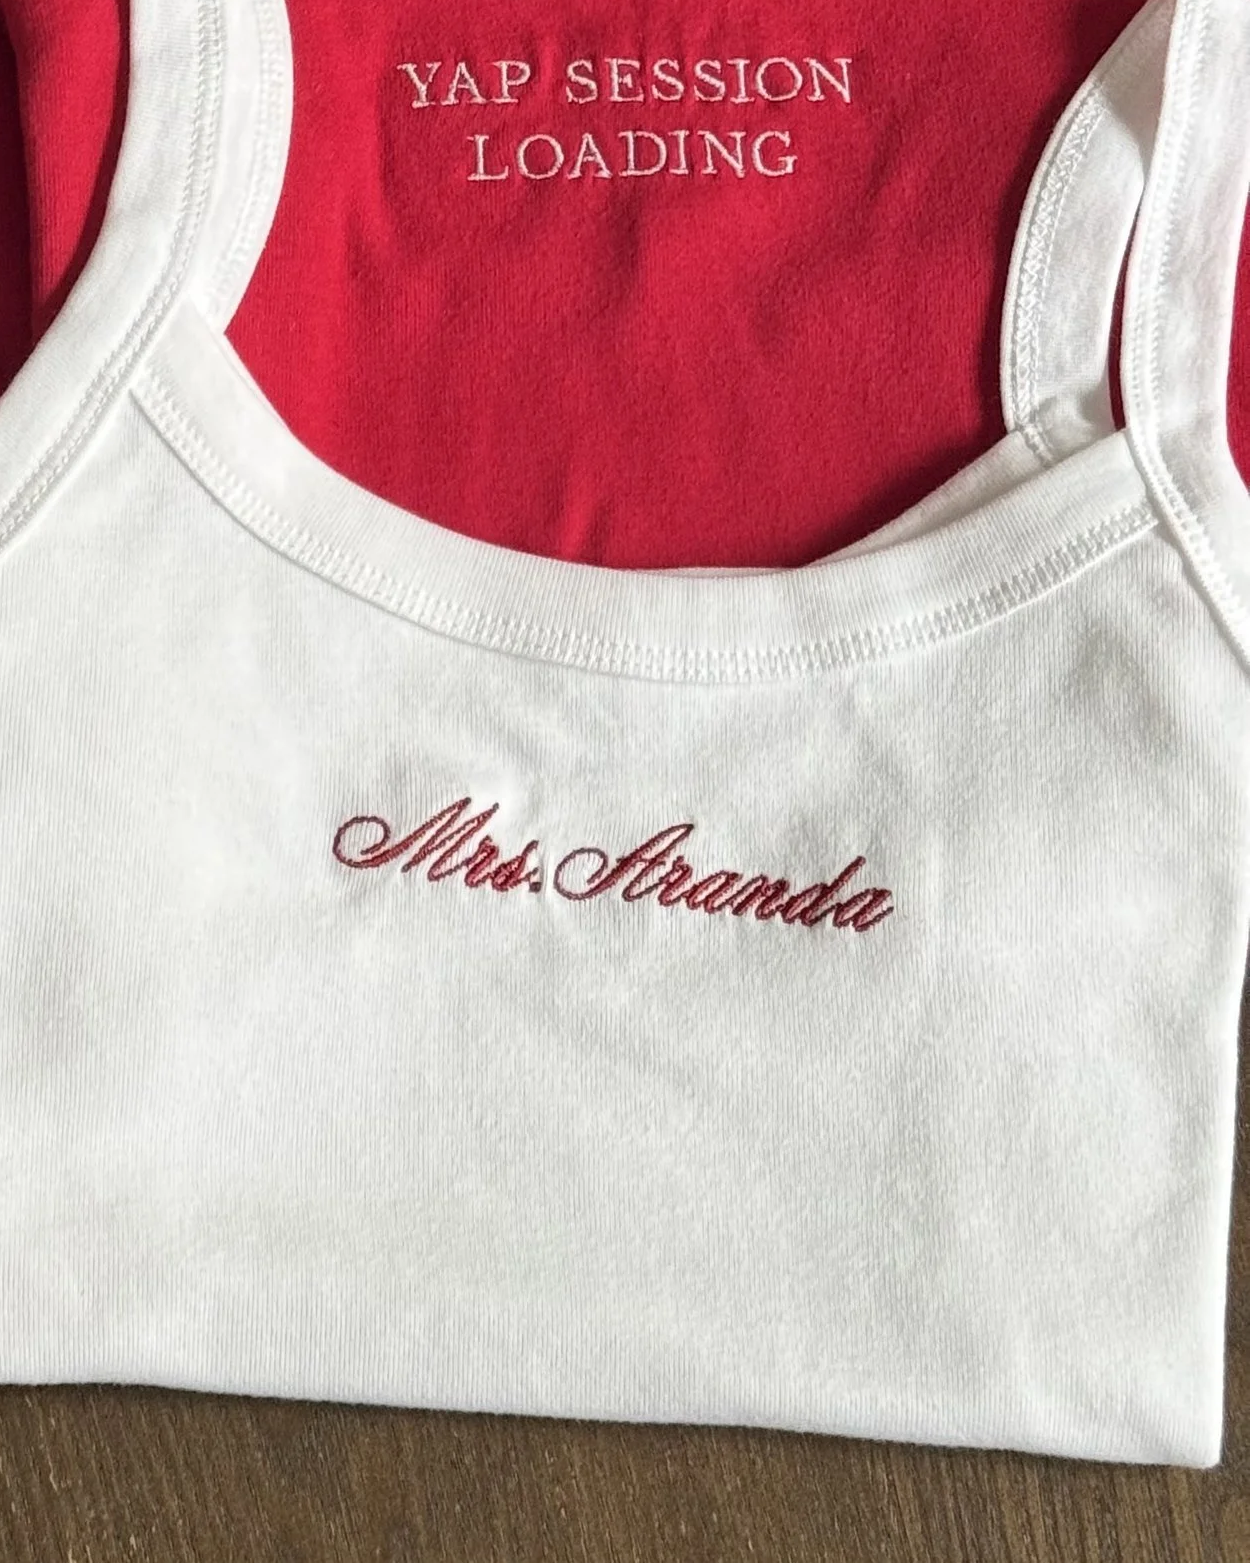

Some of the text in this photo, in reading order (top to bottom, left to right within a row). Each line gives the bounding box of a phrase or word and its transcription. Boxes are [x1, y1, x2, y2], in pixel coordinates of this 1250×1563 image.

[397, 57, 853, 109] YAP SESSION
[466, 129, 799, 182] LOADING
[333, 796, 895, 933] Mrs. Aranda
